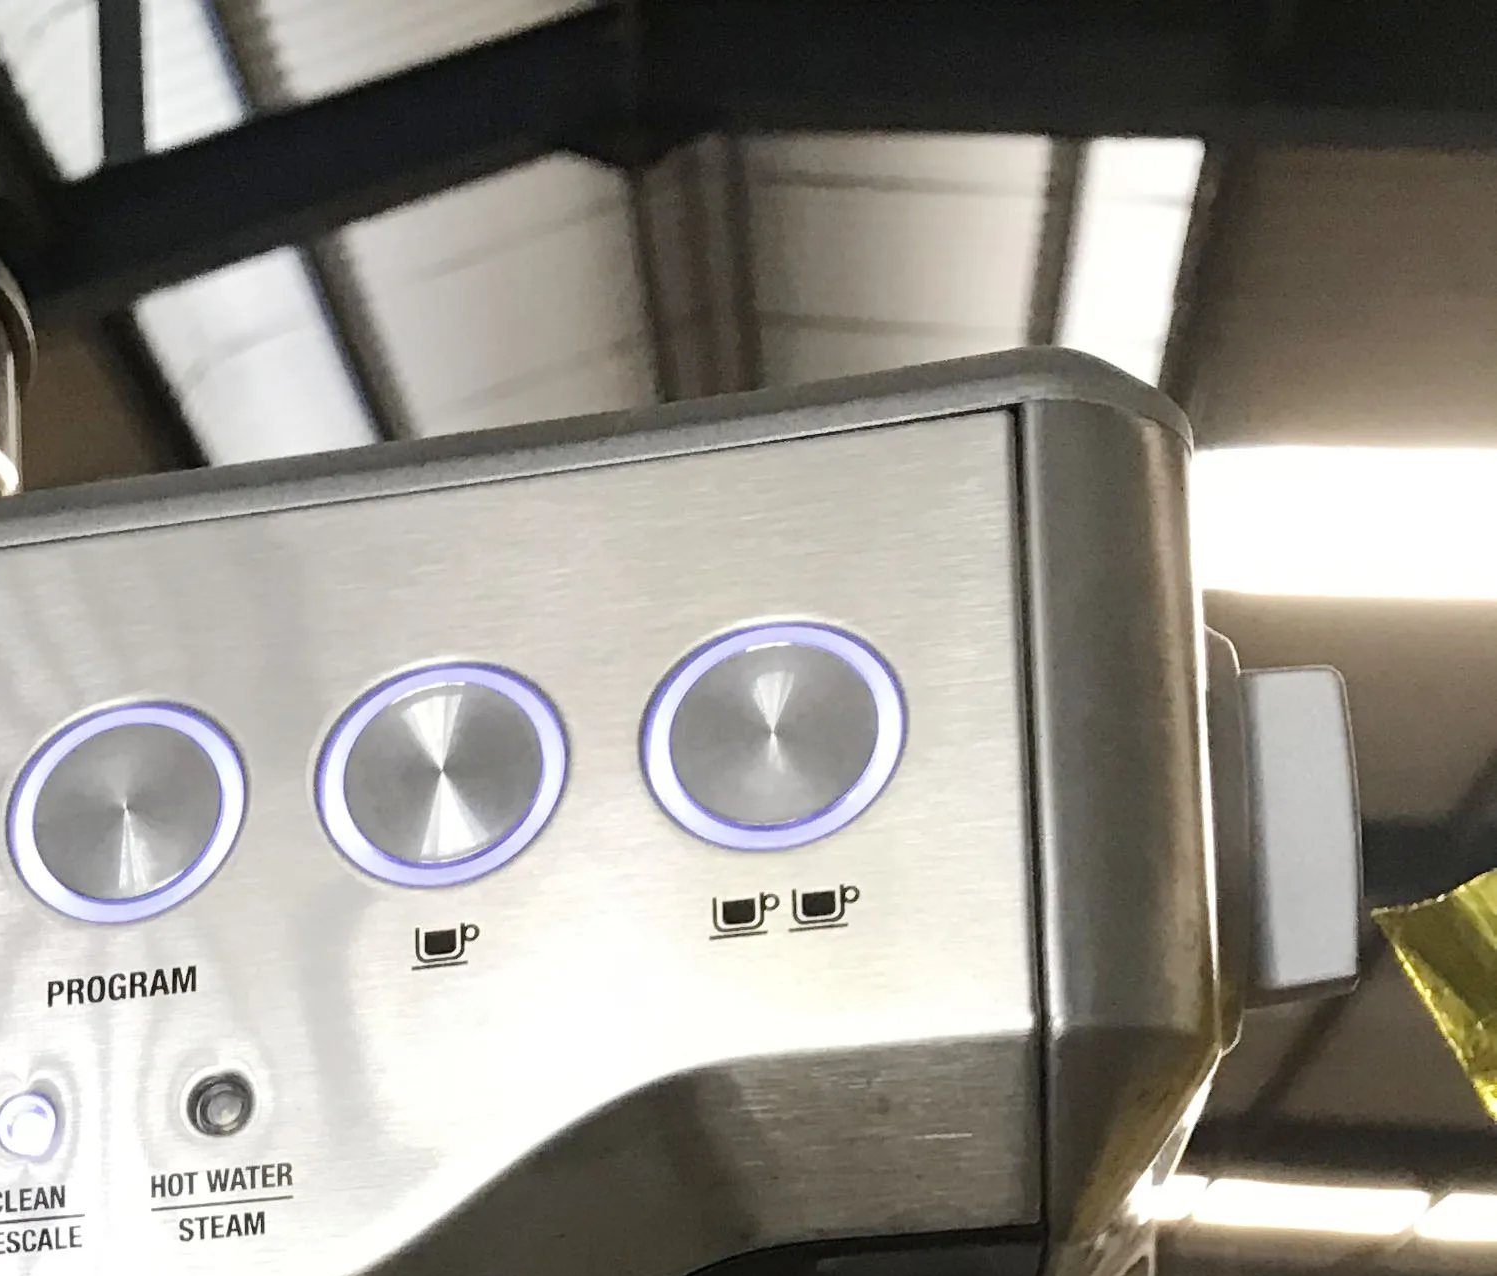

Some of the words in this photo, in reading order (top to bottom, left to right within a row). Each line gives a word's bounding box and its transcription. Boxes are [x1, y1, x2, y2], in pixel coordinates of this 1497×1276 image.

[47, 965, 197, 1007] PROGRAM
[151, 1171, 198, 1198] HOT
[206, 1162, 293, 1192] WATER
[179, 1211, 266, 1242] STEAM
